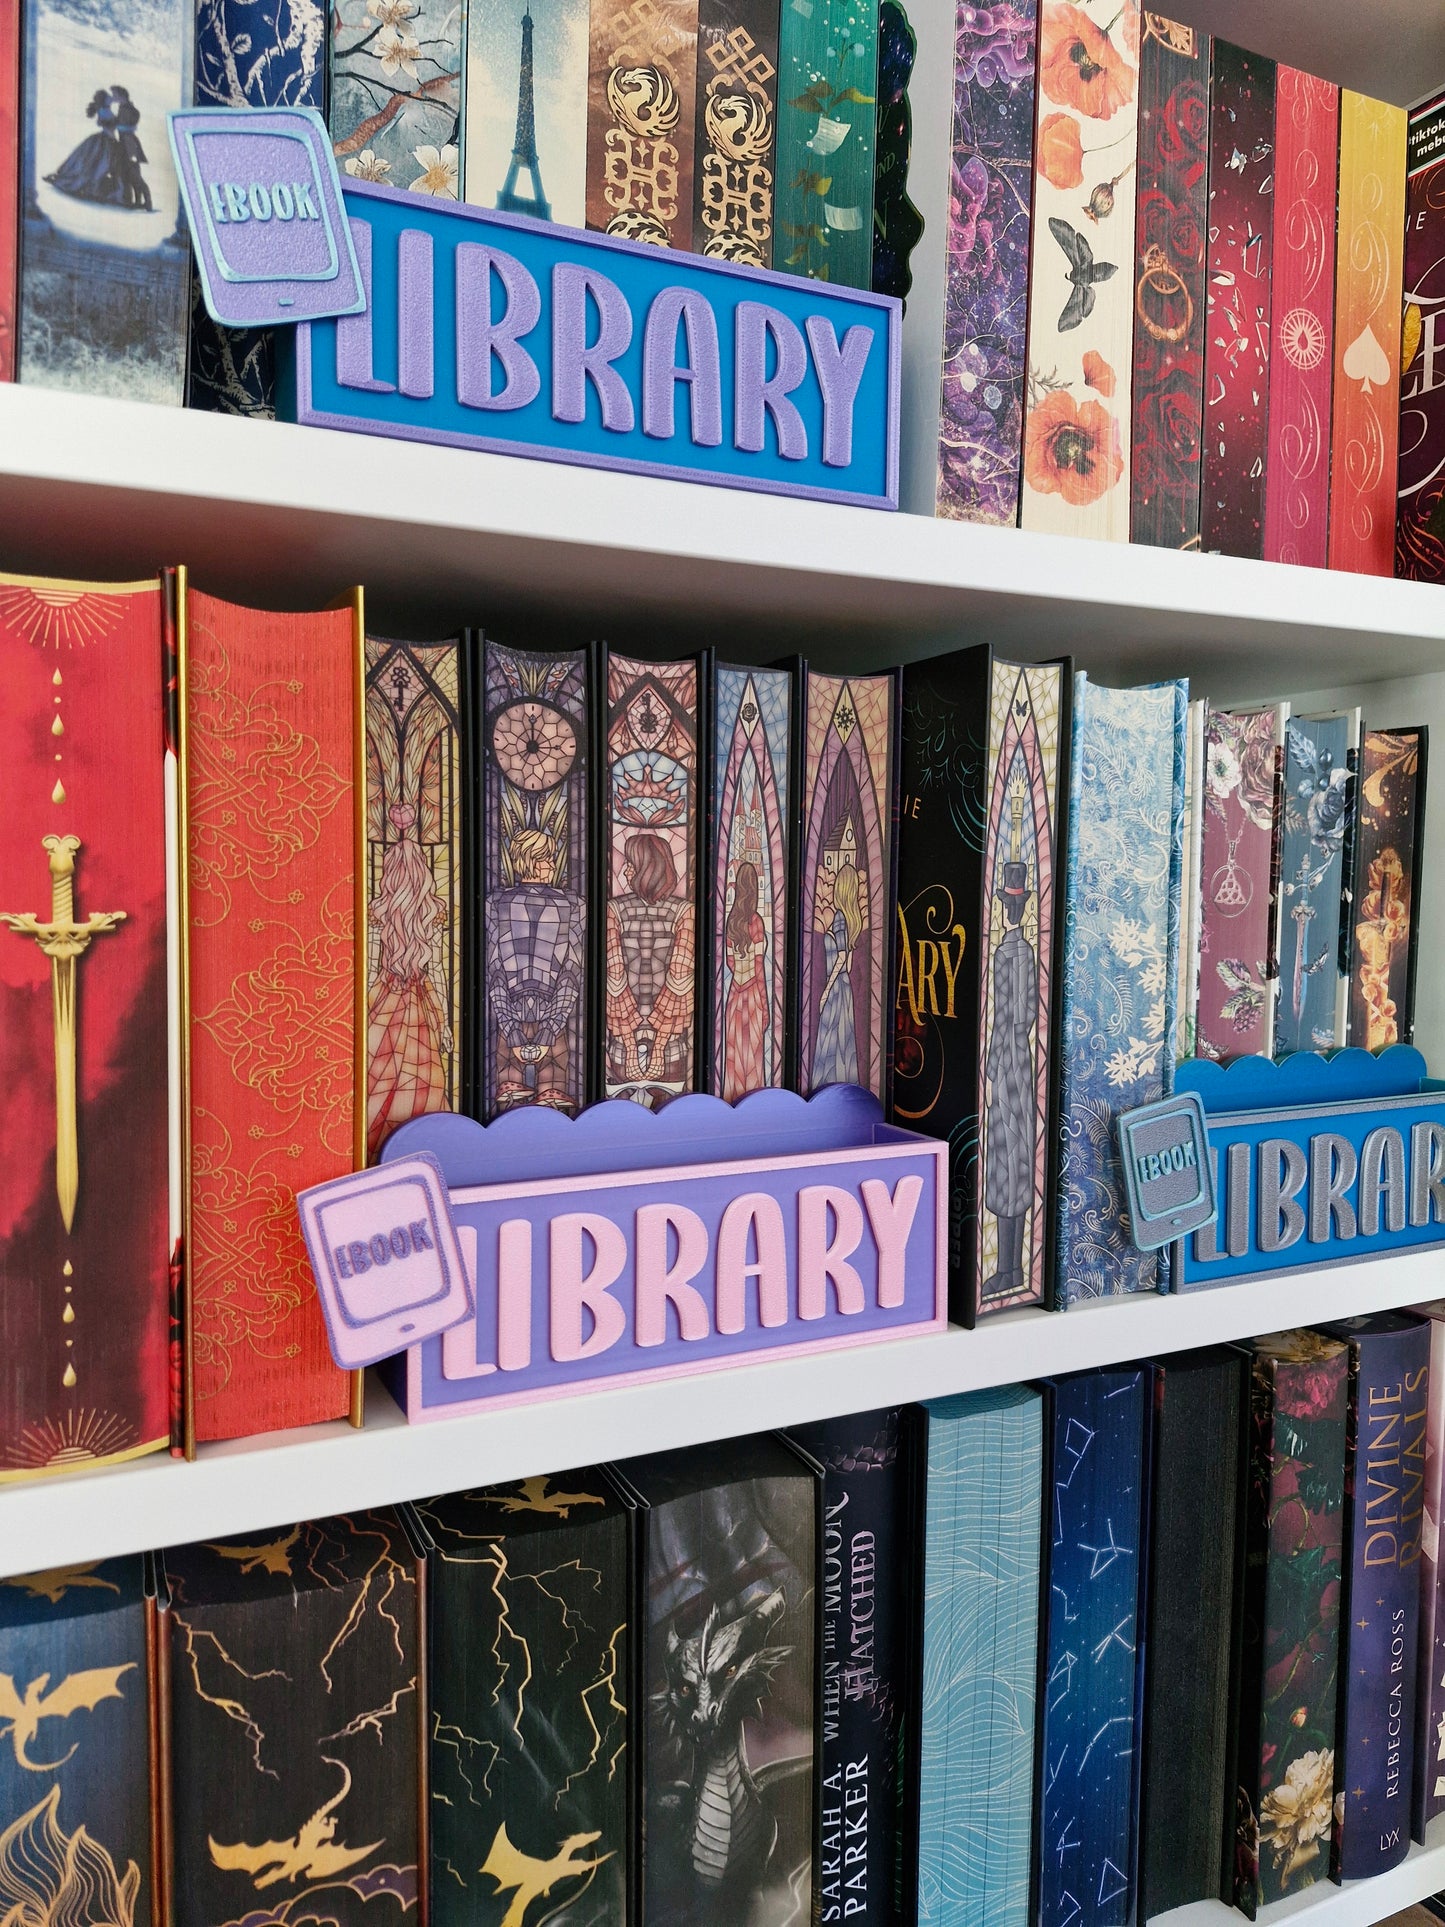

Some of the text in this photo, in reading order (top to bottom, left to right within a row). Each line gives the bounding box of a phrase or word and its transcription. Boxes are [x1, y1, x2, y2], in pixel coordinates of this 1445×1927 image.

[209, 182, 319, 223] EBOOK
[336, 217, 875, 468] LIBRARY
[334, 1217, 434, 1279] EBOOK
[1138, 1141, 1196, 1183] EBOOK
[442, 1174, 925, 1381] LIBRARY
[1364, 1383, 1402, 1569] DIVINE
[1400, 1365, 1429, 1572] RIVALS
[824, 1491, 849, 1743] WHEN THE MOON
[845, 1529, 876, 1702] HATCHED
[1386, 1608, 1404, 1799] REBECCA ROSS
[822, 1762, 842, 1922] SARAH A.
[844, 1752, 869, 1919] PARKER
[1379, 1825, 1401, 1852] LYX
